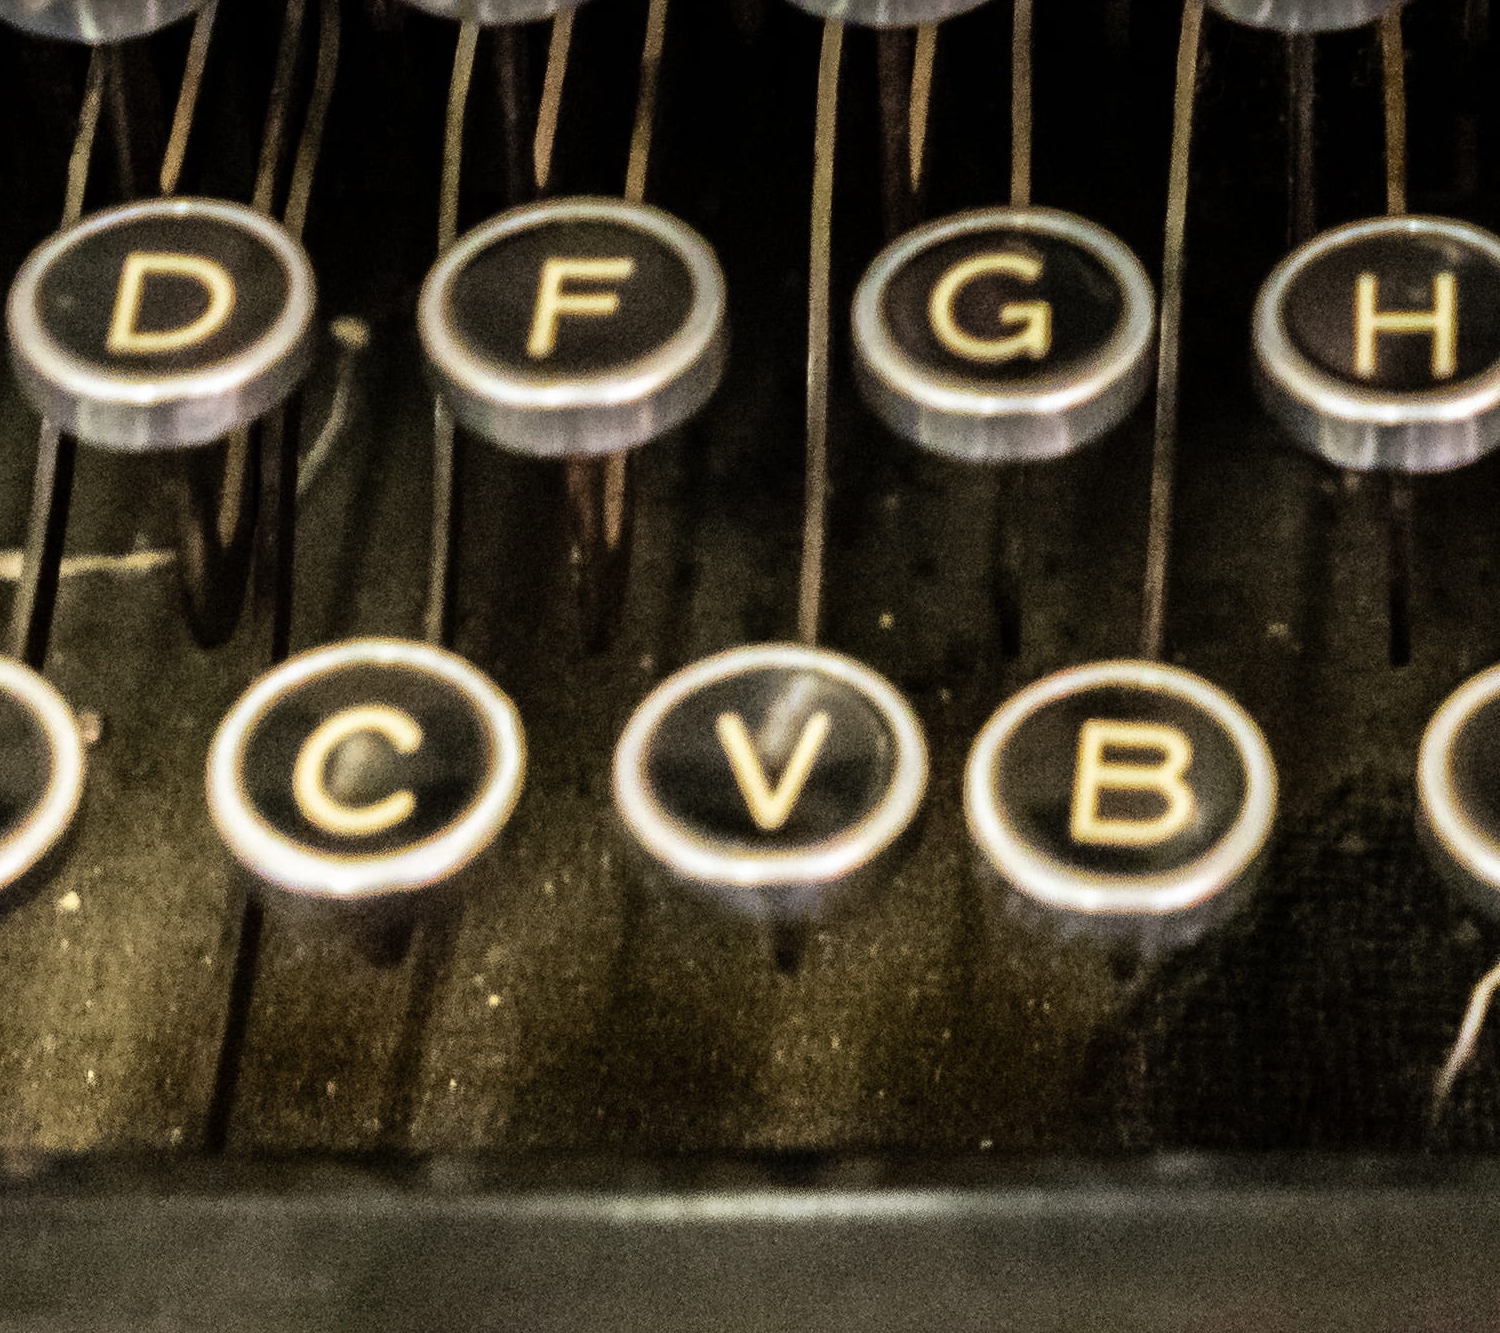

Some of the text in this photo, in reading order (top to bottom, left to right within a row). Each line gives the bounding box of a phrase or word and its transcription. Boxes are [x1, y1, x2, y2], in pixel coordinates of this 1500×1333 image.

[108, 252, 236, 353] D
[528, 257, 634, 356] F
[929, 252, 1050, 360] G
[1353, 273, 1456, 376] H
[292, 704, 422, 836] C
[716, 708, 832, 829] V
[1071, 720, 1201, 845] B
